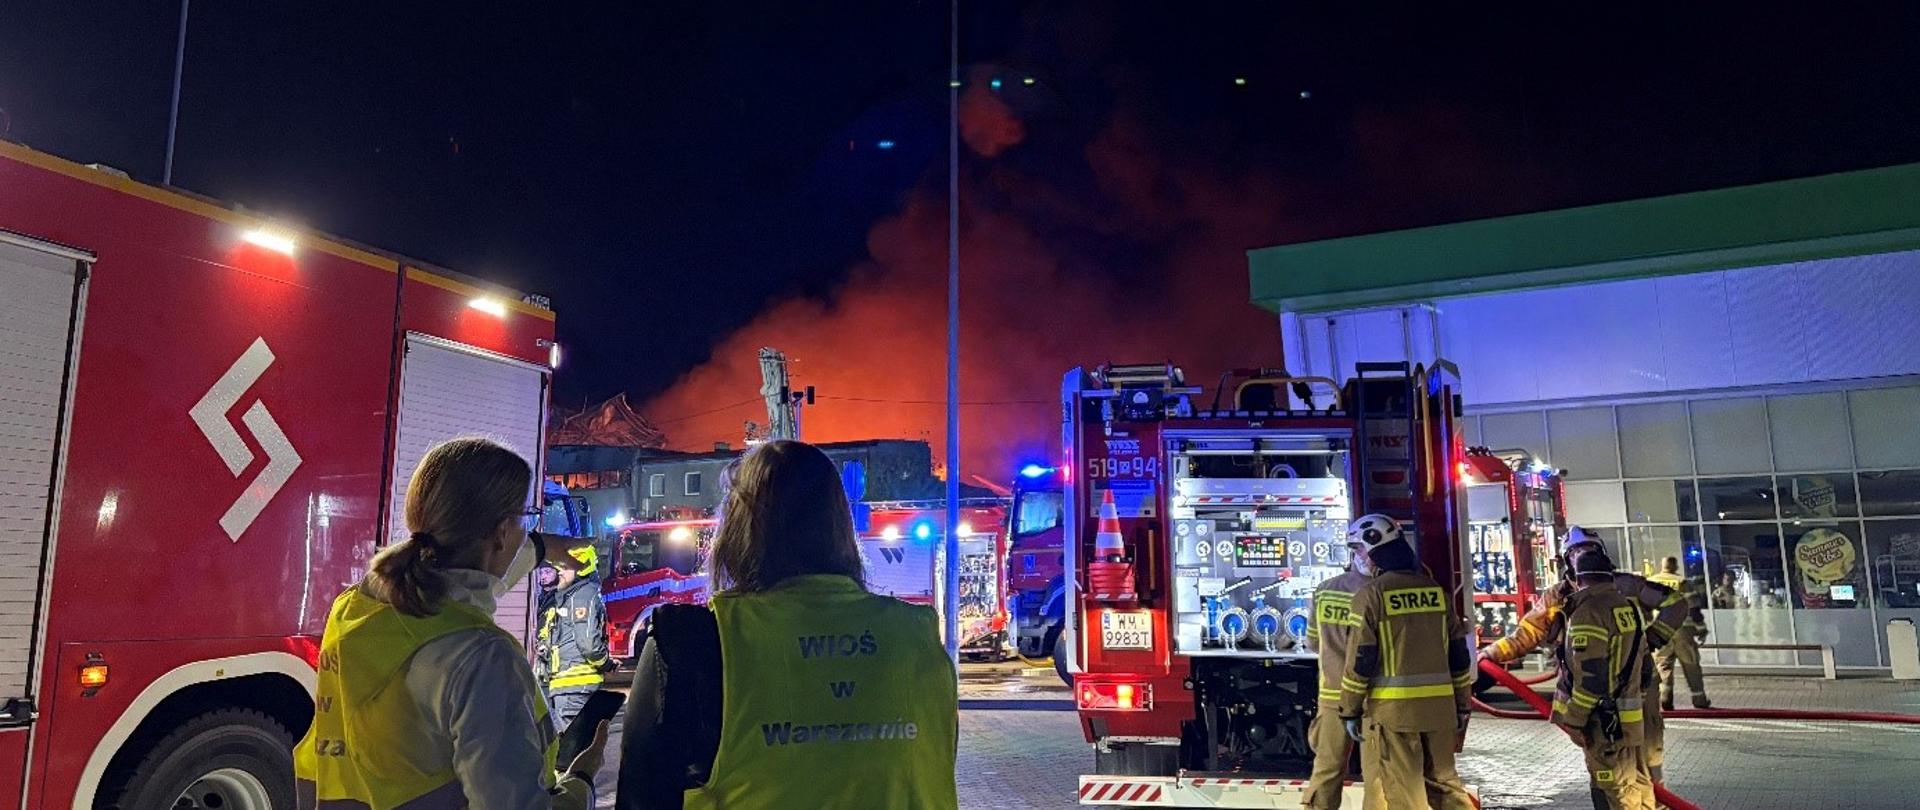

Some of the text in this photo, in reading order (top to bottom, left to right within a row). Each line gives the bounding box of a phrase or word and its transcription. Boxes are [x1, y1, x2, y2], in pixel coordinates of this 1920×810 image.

[1088, 457, 1118, 478] 519
[1132, 456, 1157, 478] 94
[1323, 604, 1350, 620] STR
[798, 629, 878, 659] WIOŚ
[1105, 631, 1149, 646] 9983T
[761, 716, 918, 747] Warszawie
